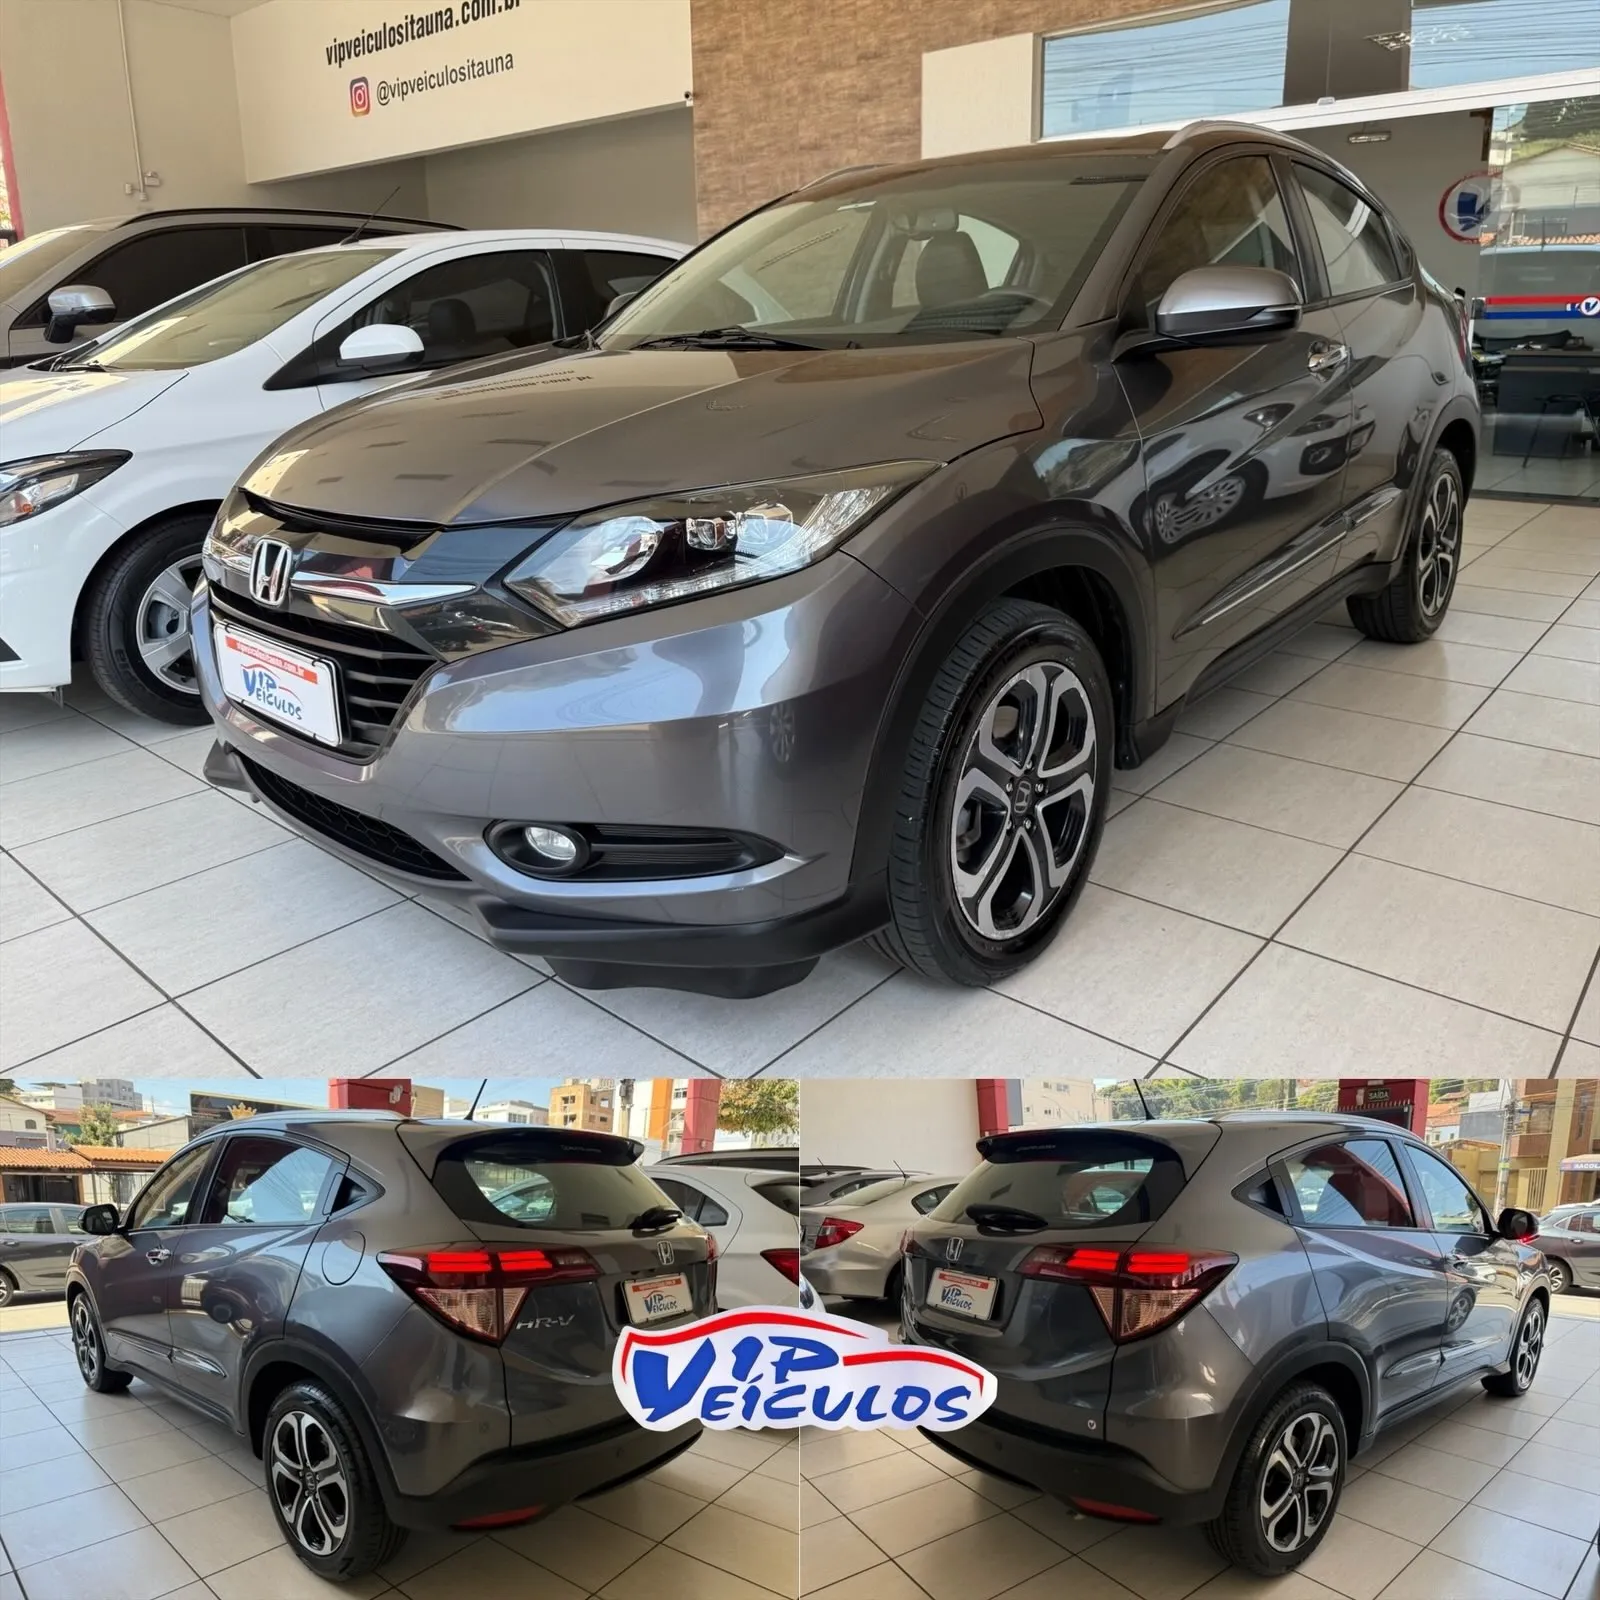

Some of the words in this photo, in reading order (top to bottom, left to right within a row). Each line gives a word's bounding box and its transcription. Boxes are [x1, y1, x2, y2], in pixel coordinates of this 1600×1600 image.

[326, 0, 520, 68] vipveiculositauna.com.
[376, 53, 514, 106] @vipveiculositauna
[516, 1314, 575, 1330] HR-V
